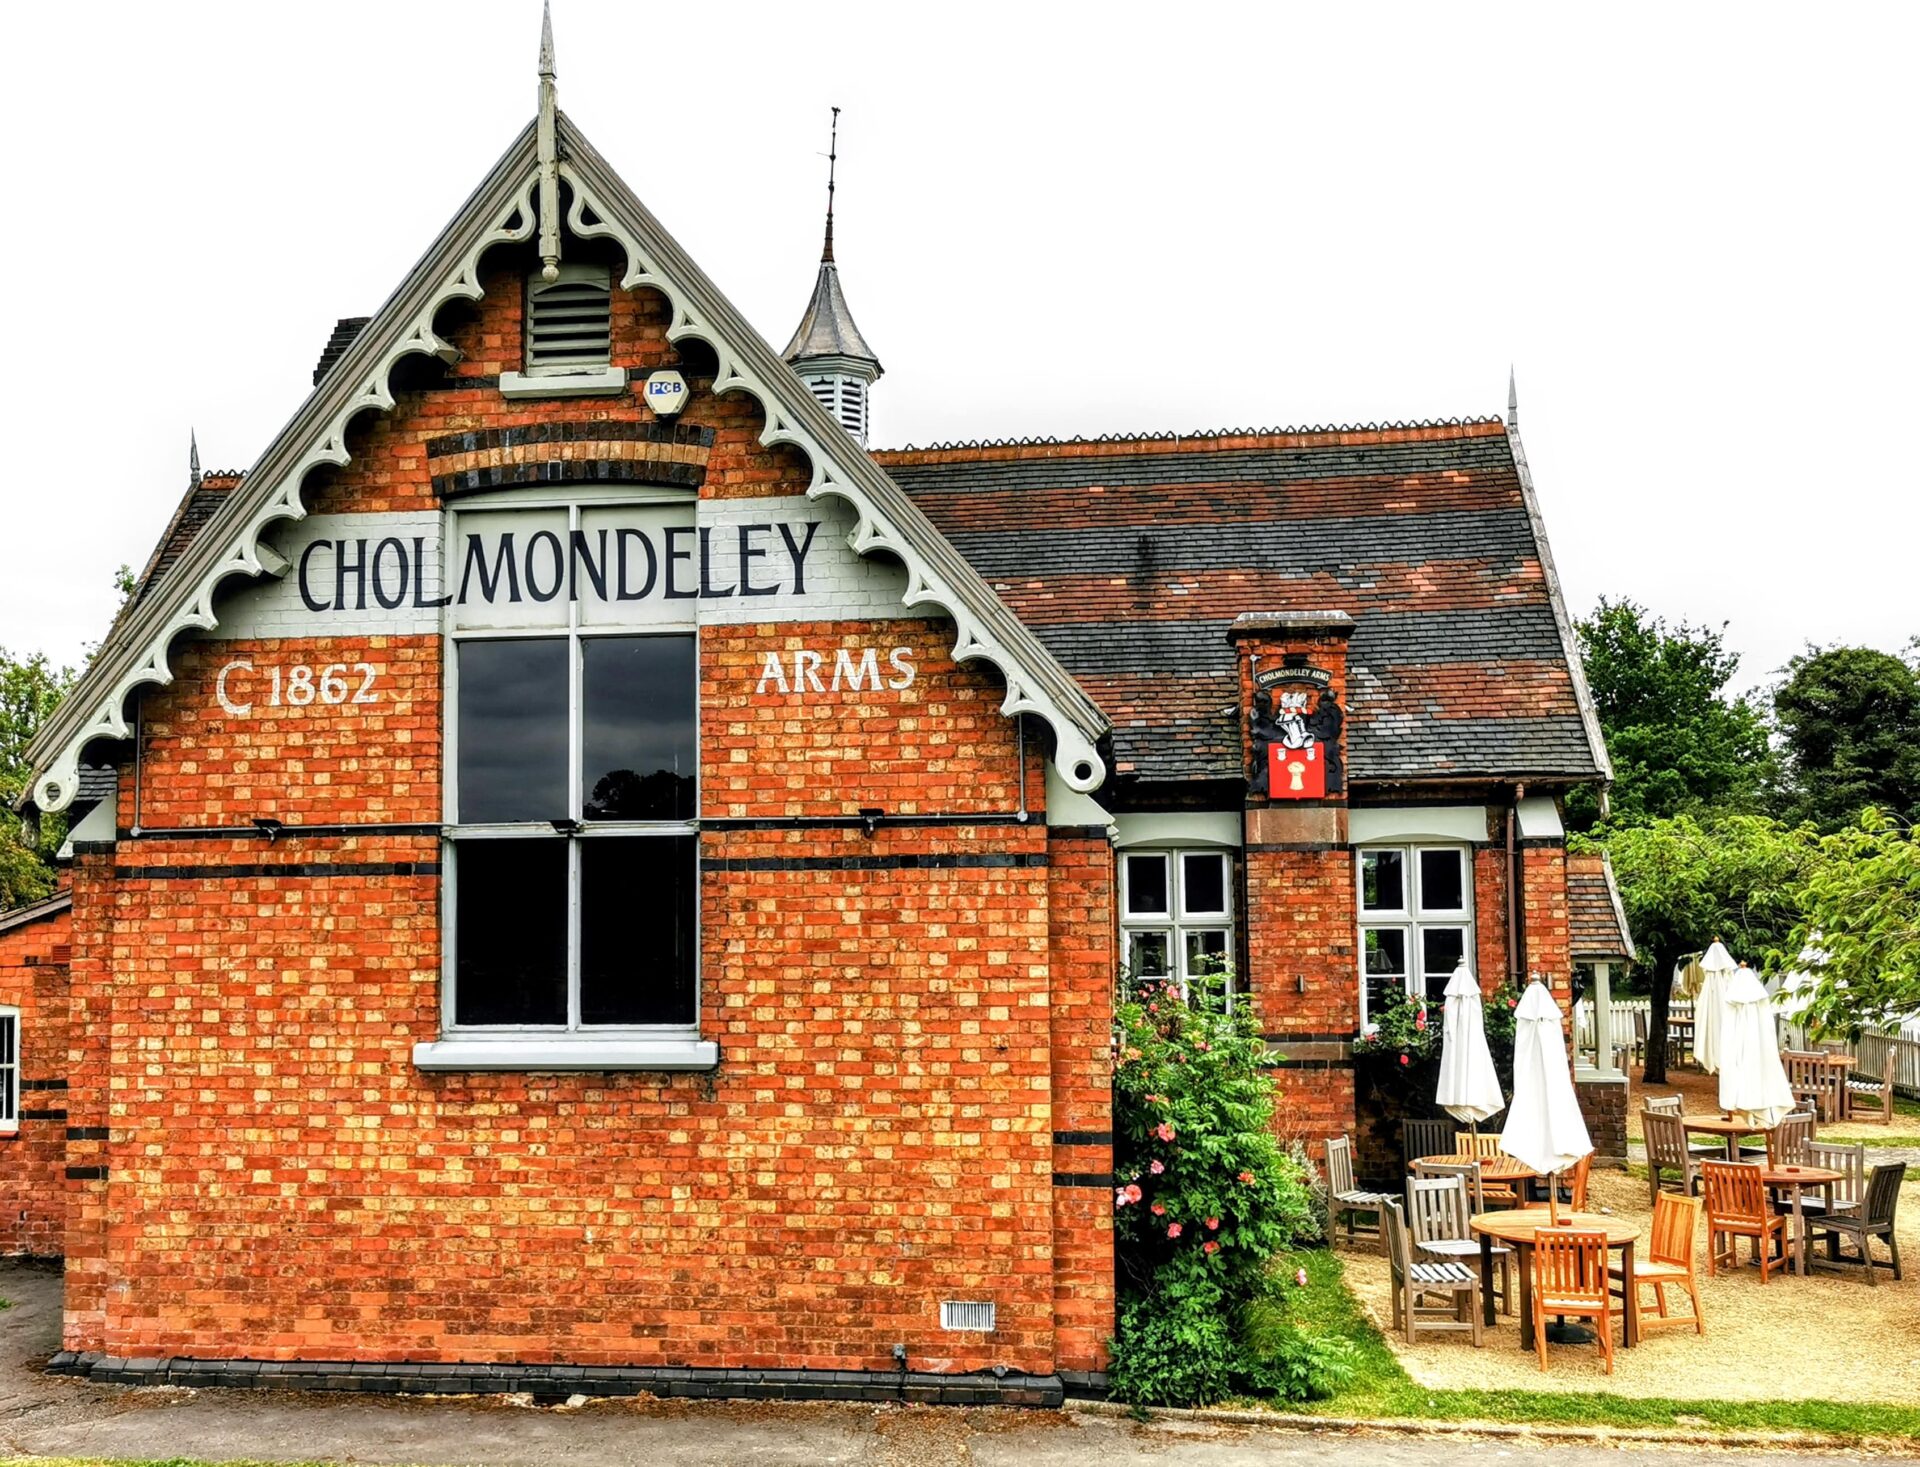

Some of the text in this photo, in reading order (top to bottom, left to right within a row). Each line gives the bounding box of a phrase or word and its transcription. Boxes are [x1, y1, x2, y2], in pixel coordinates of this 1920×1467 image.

[651, 381, 682, 394] PCB
[298, 520, 822, 612] CHOLMONDELEY
[216, 660, 379, 716] C 1862
[755, 646, 916, 695] ARMS
[1259, 668, 1330, 683] CHOLMONDELEY ARMS
